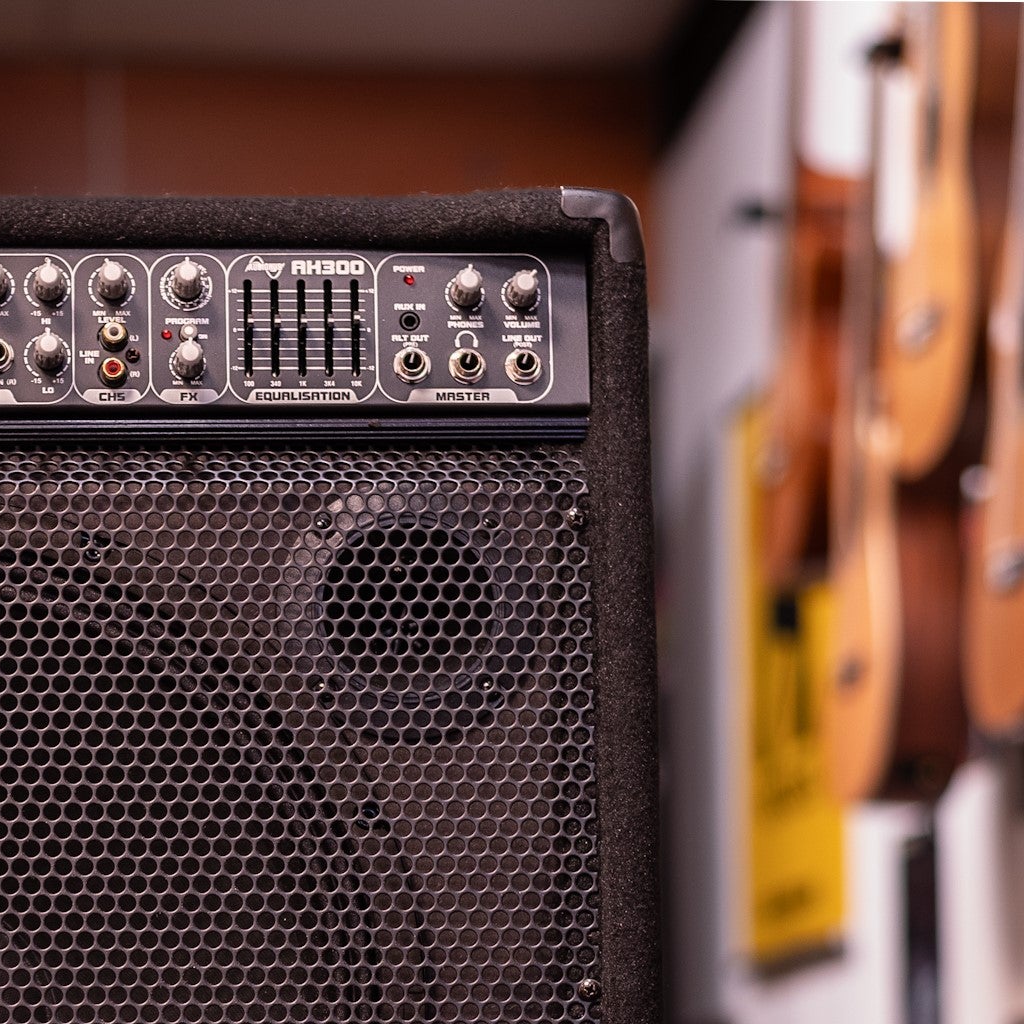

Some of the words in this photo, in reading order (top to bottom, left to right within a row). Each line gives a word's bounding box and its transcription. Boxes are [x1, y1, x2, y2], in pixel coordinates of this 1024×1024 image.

[291, 260, 365, 275] AH300
[99, 392, 125, 401] CH5
[180, 393, 198, 401] FX
[256, 392, 350, 401] EQUALISATION
[436, 392, 490, 401] MASTER
